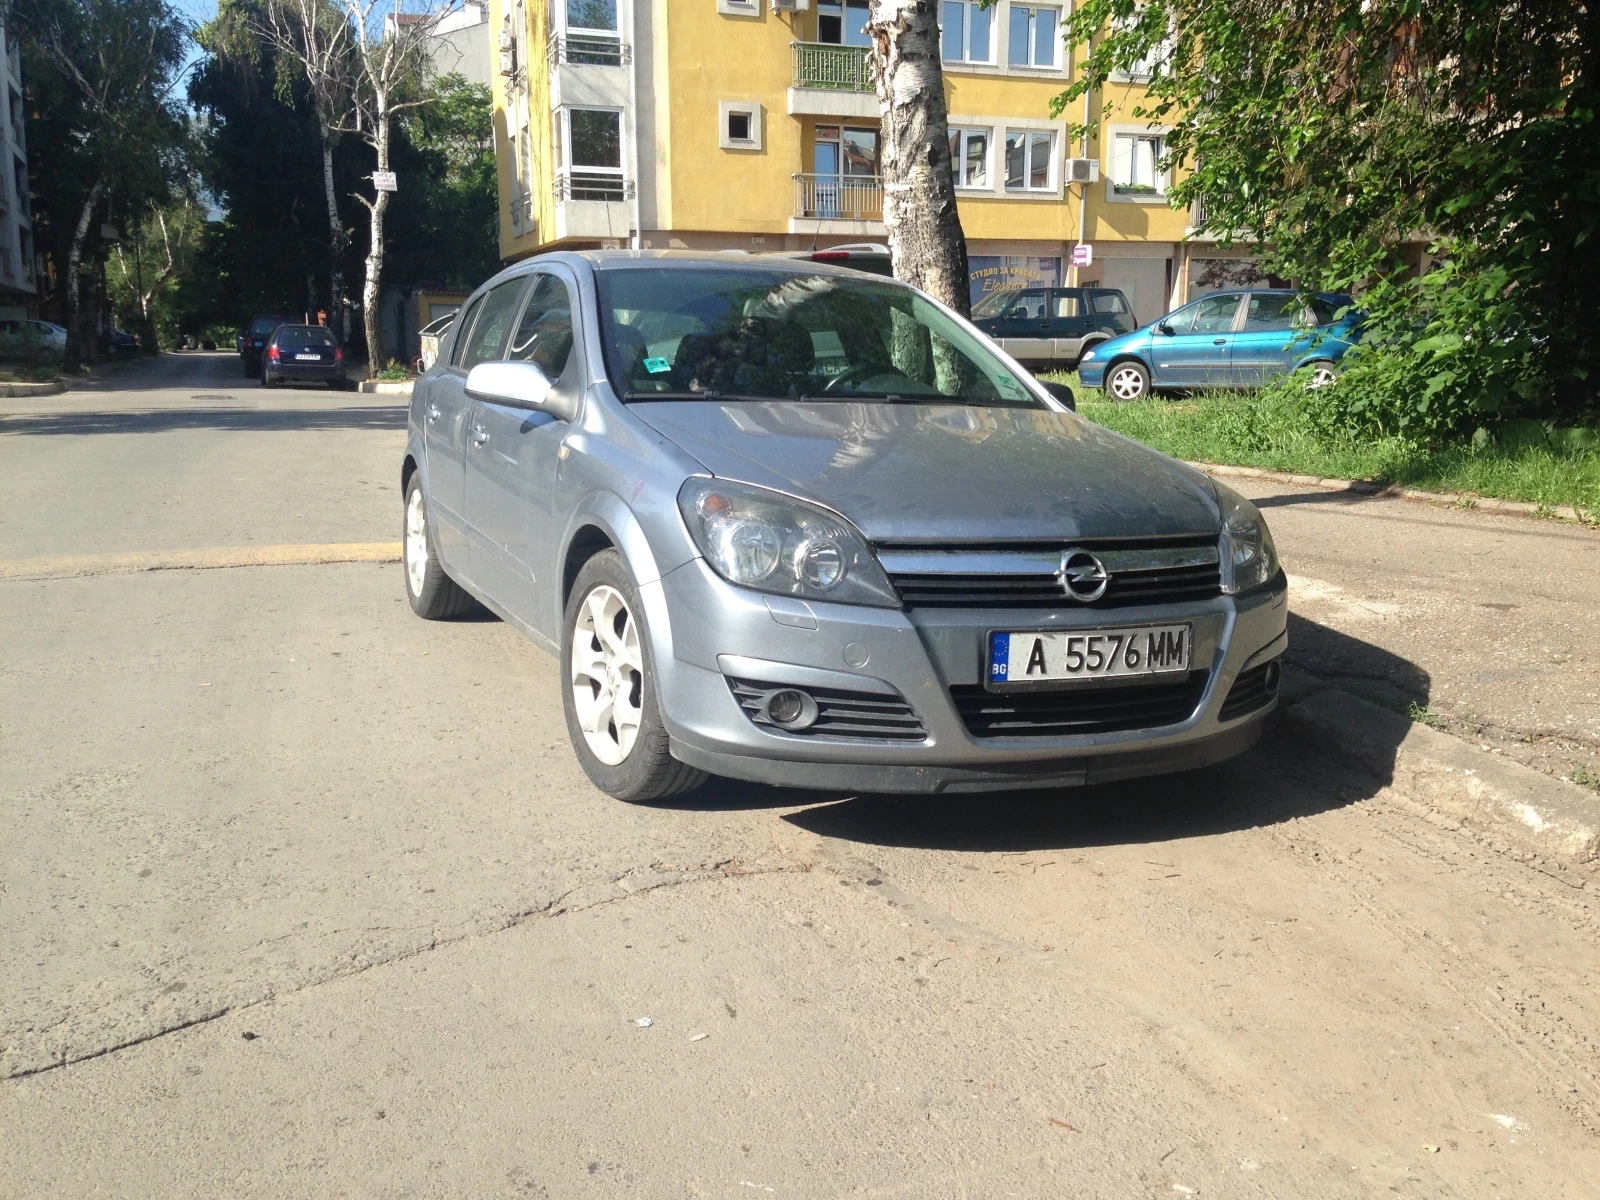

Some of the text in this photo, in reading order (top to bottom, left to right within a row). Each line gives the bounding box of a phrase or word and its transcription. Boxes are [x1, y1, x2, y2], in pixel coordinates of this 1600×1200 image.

[970, 267, 998, 280] СТУДИО
[1010, 267, 1041, 281] КРАСОТА
[1025, 630, 1185, 675] A 5576 MM
[992, 663, 1007, 675] BG
